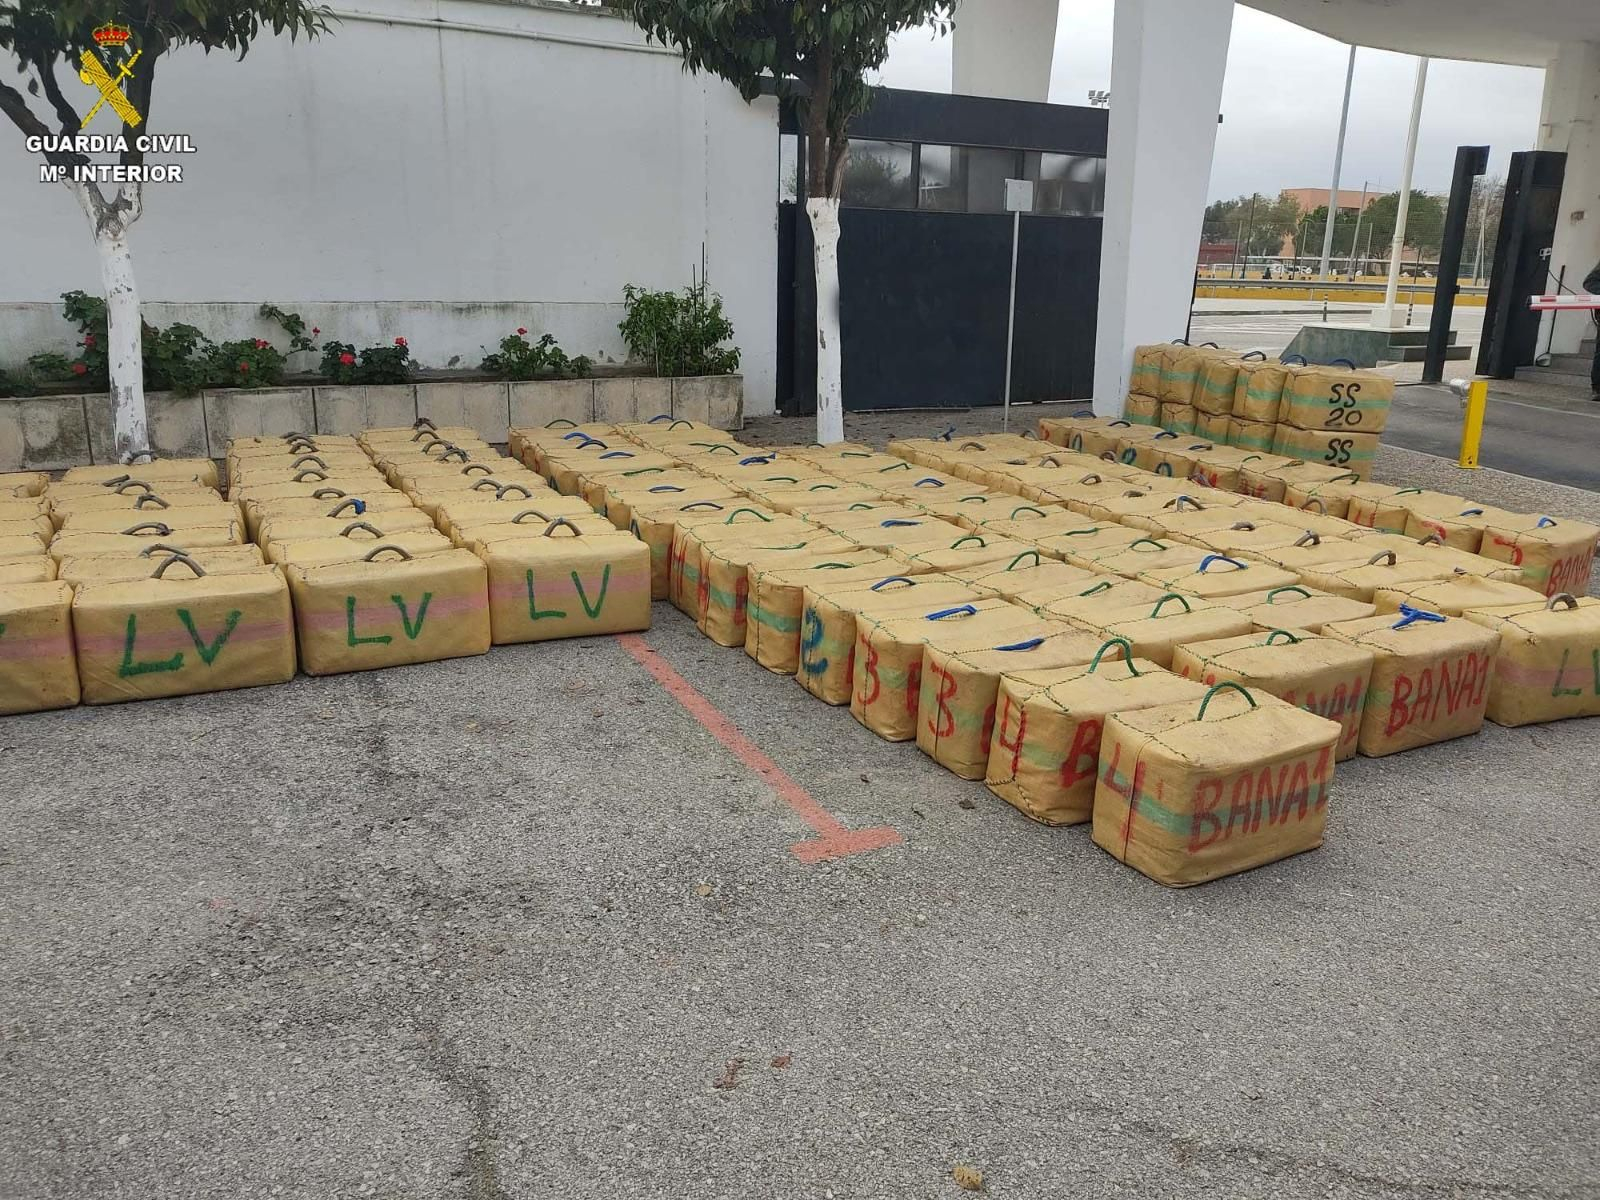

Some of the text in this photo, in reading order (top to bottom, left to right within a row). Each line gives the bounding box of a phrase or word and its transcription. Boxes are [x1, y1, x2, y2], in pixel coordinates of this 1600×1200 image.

[1324, 407, 1362, 427] 20
[1328, 383, 1361, 408] SS
[1324, 438, 1354, 464] SS
[346, 592, 432, 647] LV
[522, 564, 611, 620] LV
[118, 608, 242, 678] LV
[857, 632, 881, 705] 3
[928, 662, 958, 738] 3
[999, 695, 1026, 776] 4
[1103, 742, 1146, 842] 4
